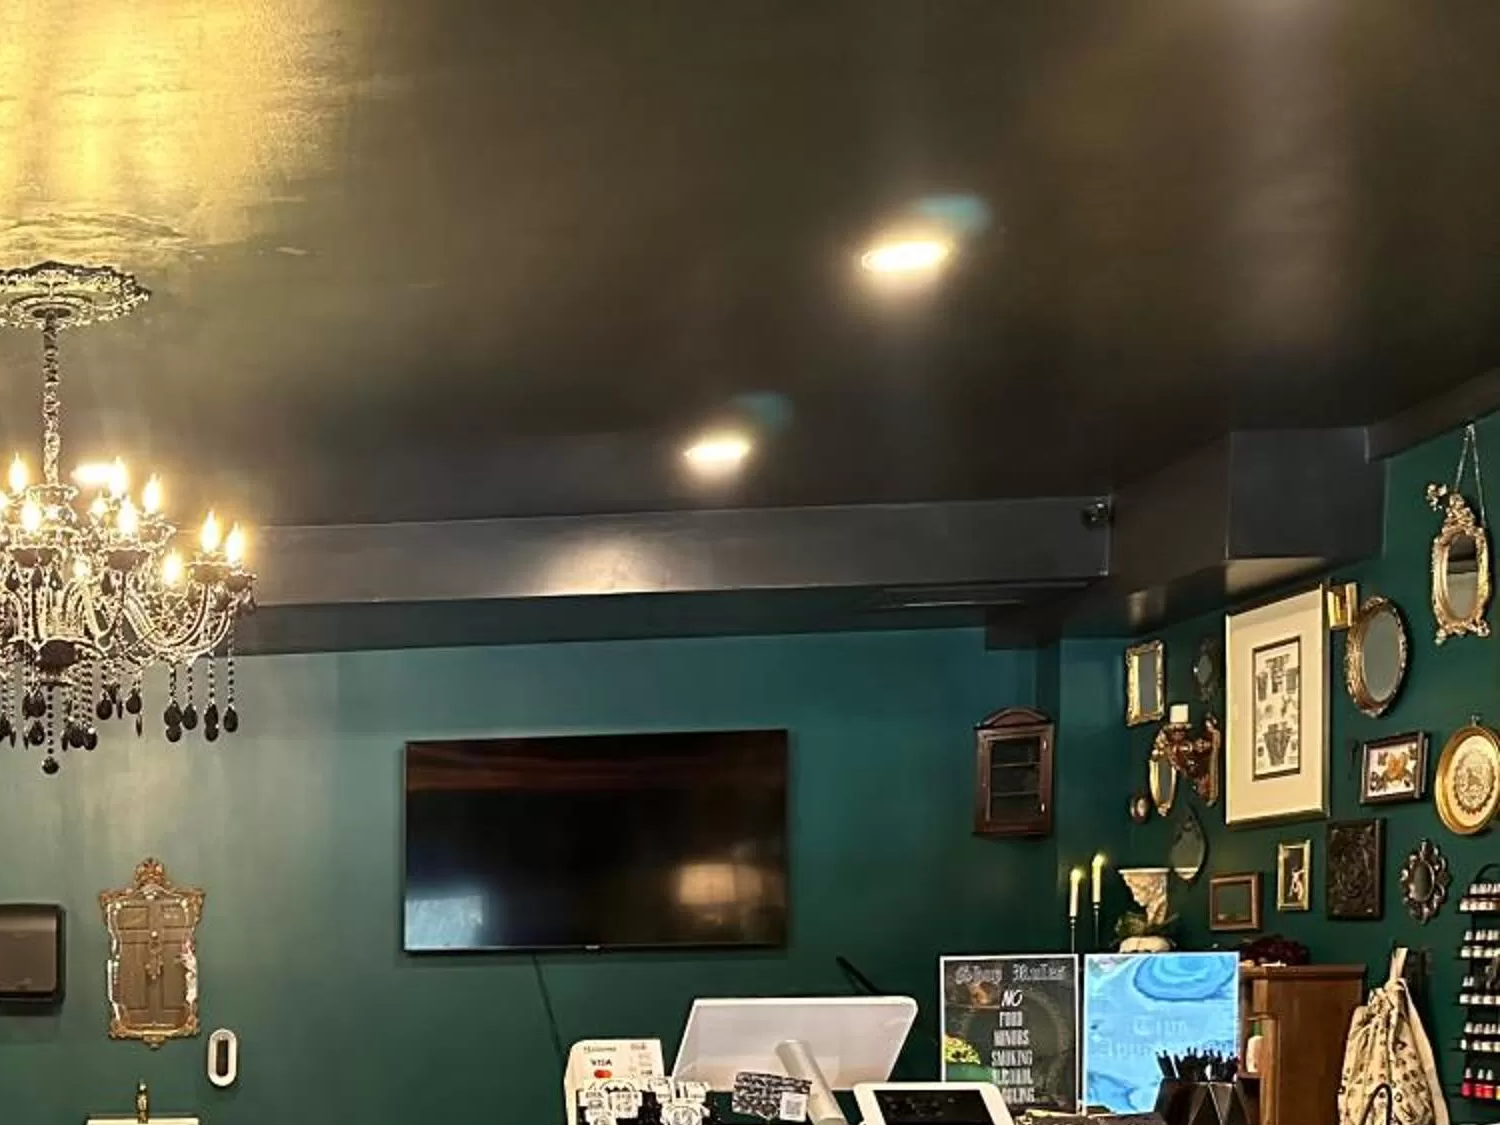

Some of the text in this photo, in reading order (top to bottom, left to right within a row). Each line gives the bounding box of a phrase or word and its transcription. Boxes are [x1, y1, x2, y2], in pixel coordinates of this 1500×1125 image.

[1001, 988, 1024, 1008] NO
[999, 1010, 1023, 1028] FOOD
[993, 1029, 1030, 1047] MINORS
[590, 1058, 613, 1068] VISA
[991, 1049, 1034, 1068] SMOKING
